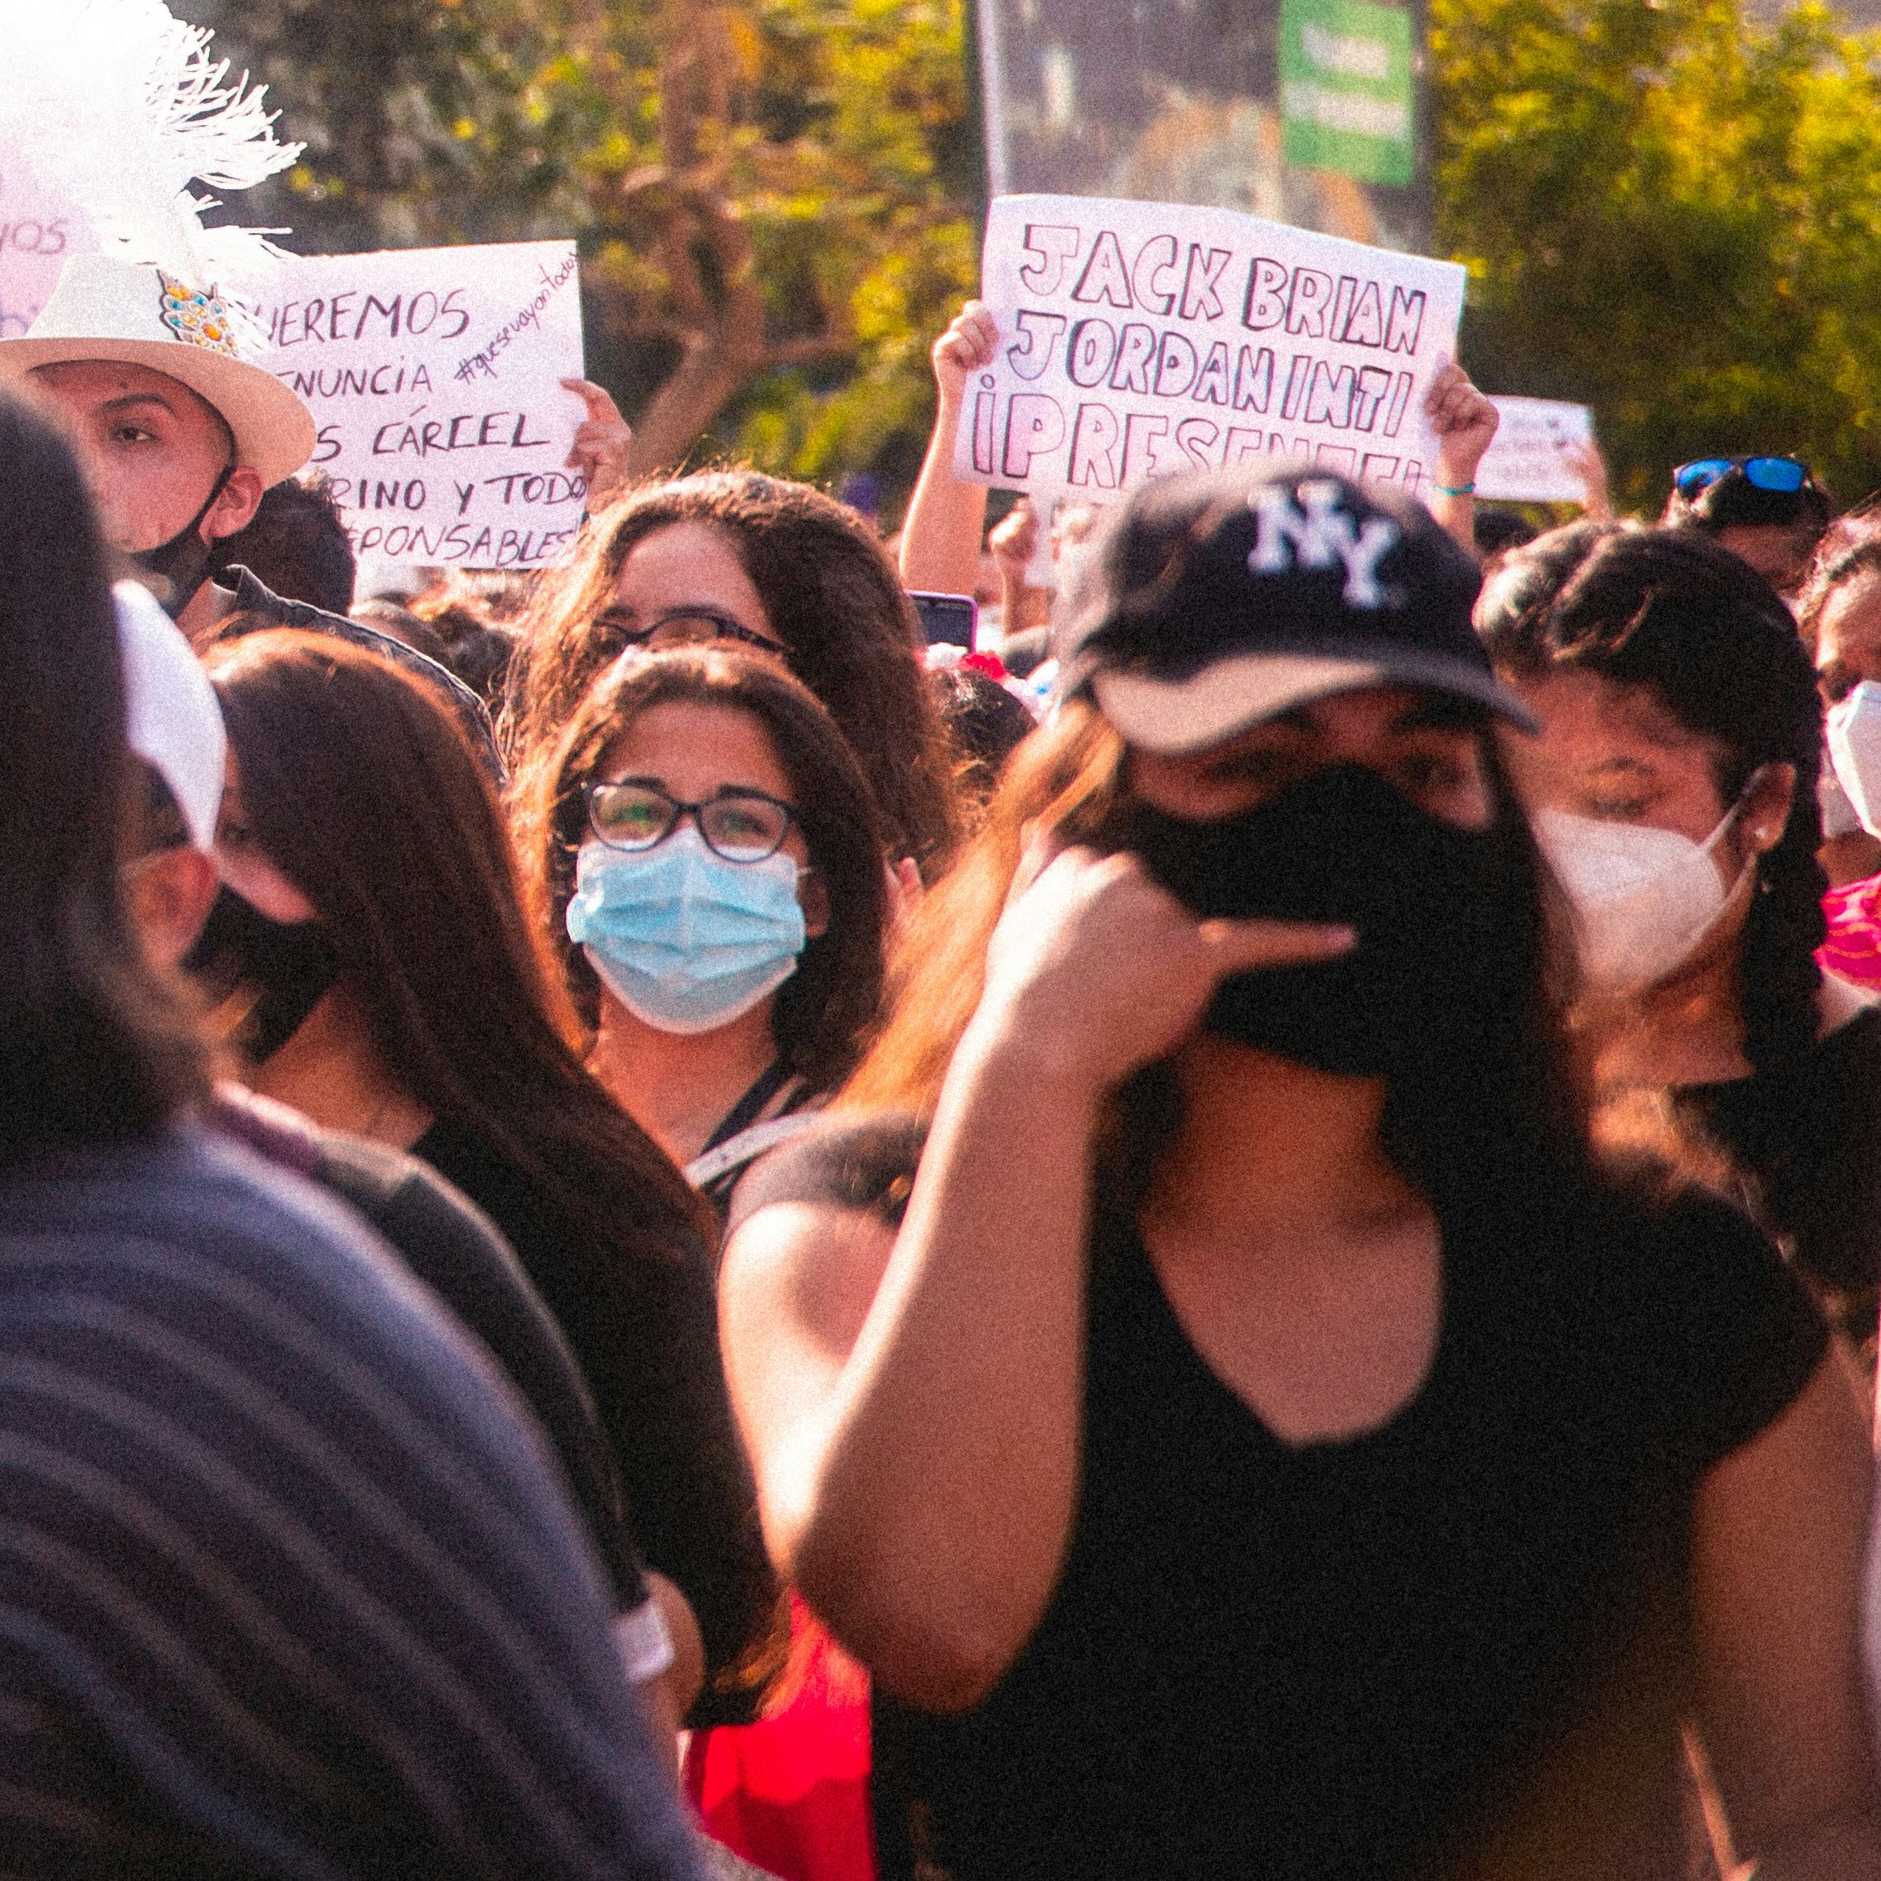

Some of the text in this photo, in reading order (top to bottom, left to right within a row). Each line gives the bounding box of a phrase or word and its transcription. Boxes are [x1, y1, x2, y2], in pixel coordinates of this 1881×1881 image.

[252, 287, 471, 348] UEREMOS
[1019, 223, 1426, 356] JACK BRIAN
[276, 354, 435, 399] NUNCIA
[1006, 308, 1415, 439] JORDAN INTI
[310, 424, 343, 463] S
[326, 477, 427, 511] RINO
[1246, 479, 1402, 611] NY
